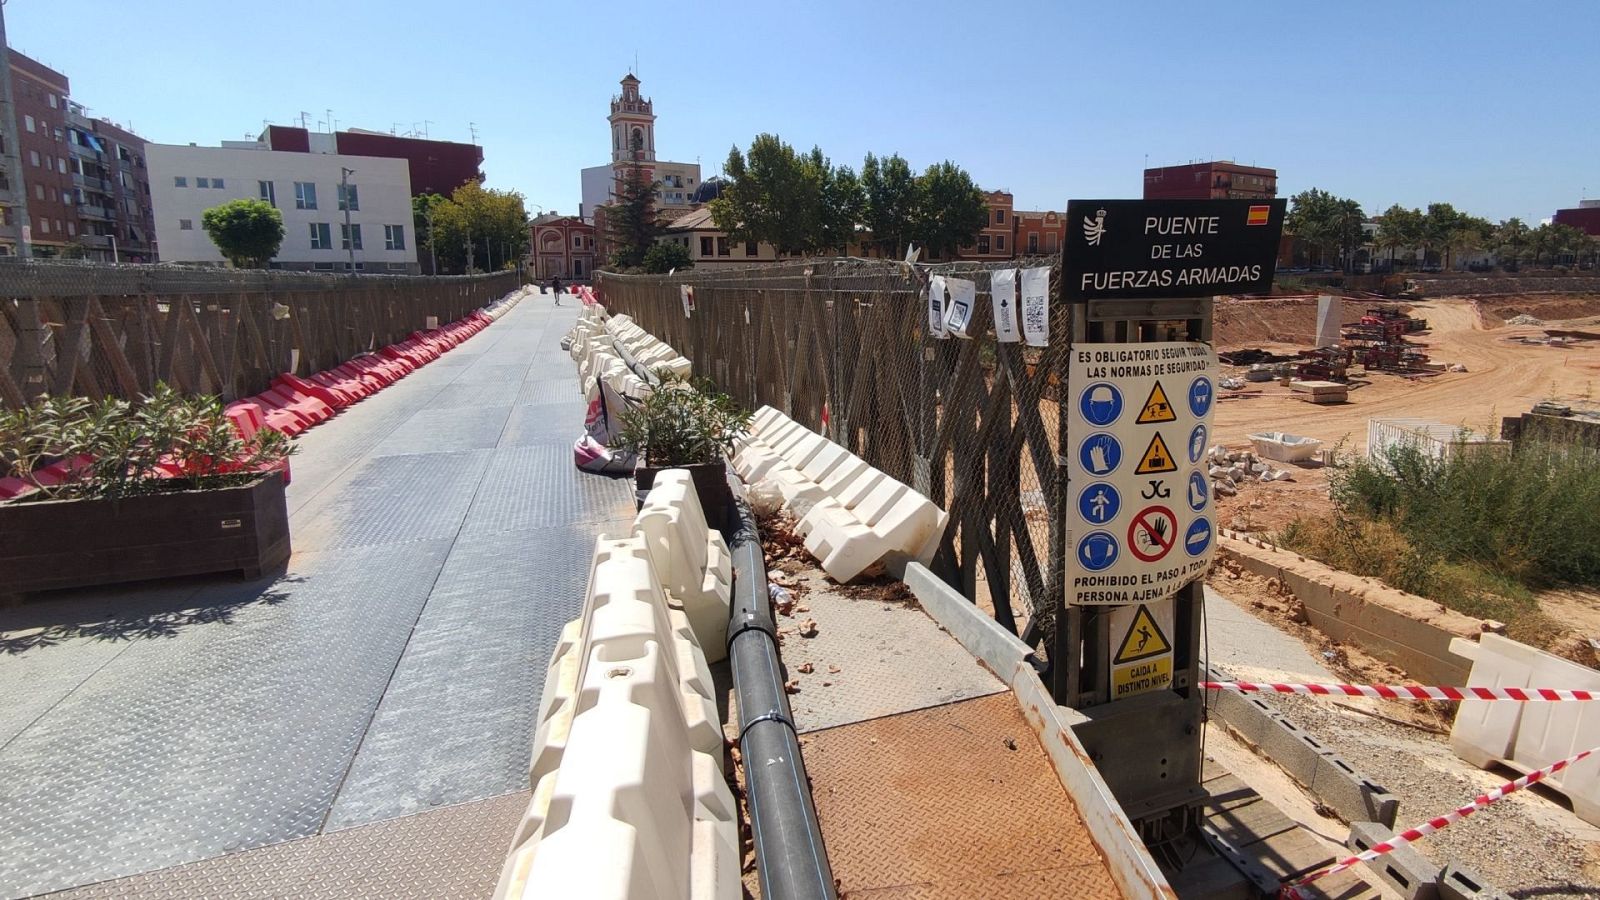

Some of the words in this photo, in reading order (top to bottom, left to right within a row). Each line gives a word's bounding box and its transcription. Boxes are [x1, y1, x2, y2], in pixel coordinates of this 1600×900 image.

[1144, 216, 1220, 235] PUENTE
[1151, 244, 1171, 259] DE
[1176, 243, 1203, 258] LAS
[1081, 269, 1172, 291] FUERZAS
[1176, 265, 1261, 286] ARMADAS
[1078, 351, 1091, 363] ES
[1095, 349, 1159, 362] OBLIGATORIO
[1161, 347, 1186, 359] SEGUIR
[1087, 367, 1107, 378] LAS
[1110, 365, 1151, 378] NORMAS
[1154, 364, 1164, 375] DE
[1166, 360, 1206, 374] SEGURIDAD
[1074, 575, 1138, 587] PROHIBIDO
[1141, 573, 1153, 585] EL
[1156, 568, 1179, 582] PASO
[1181, 565, 1187, 575] A
[1077, 591, 1128, 603] PERSONA
[1132, 587, 1164, 601] AJENA
[1152, 663, 1158, 673] A
[1117, 679, 1150, 695] DISTINTO
[1151, 673, 1170, 686] NIVEL
